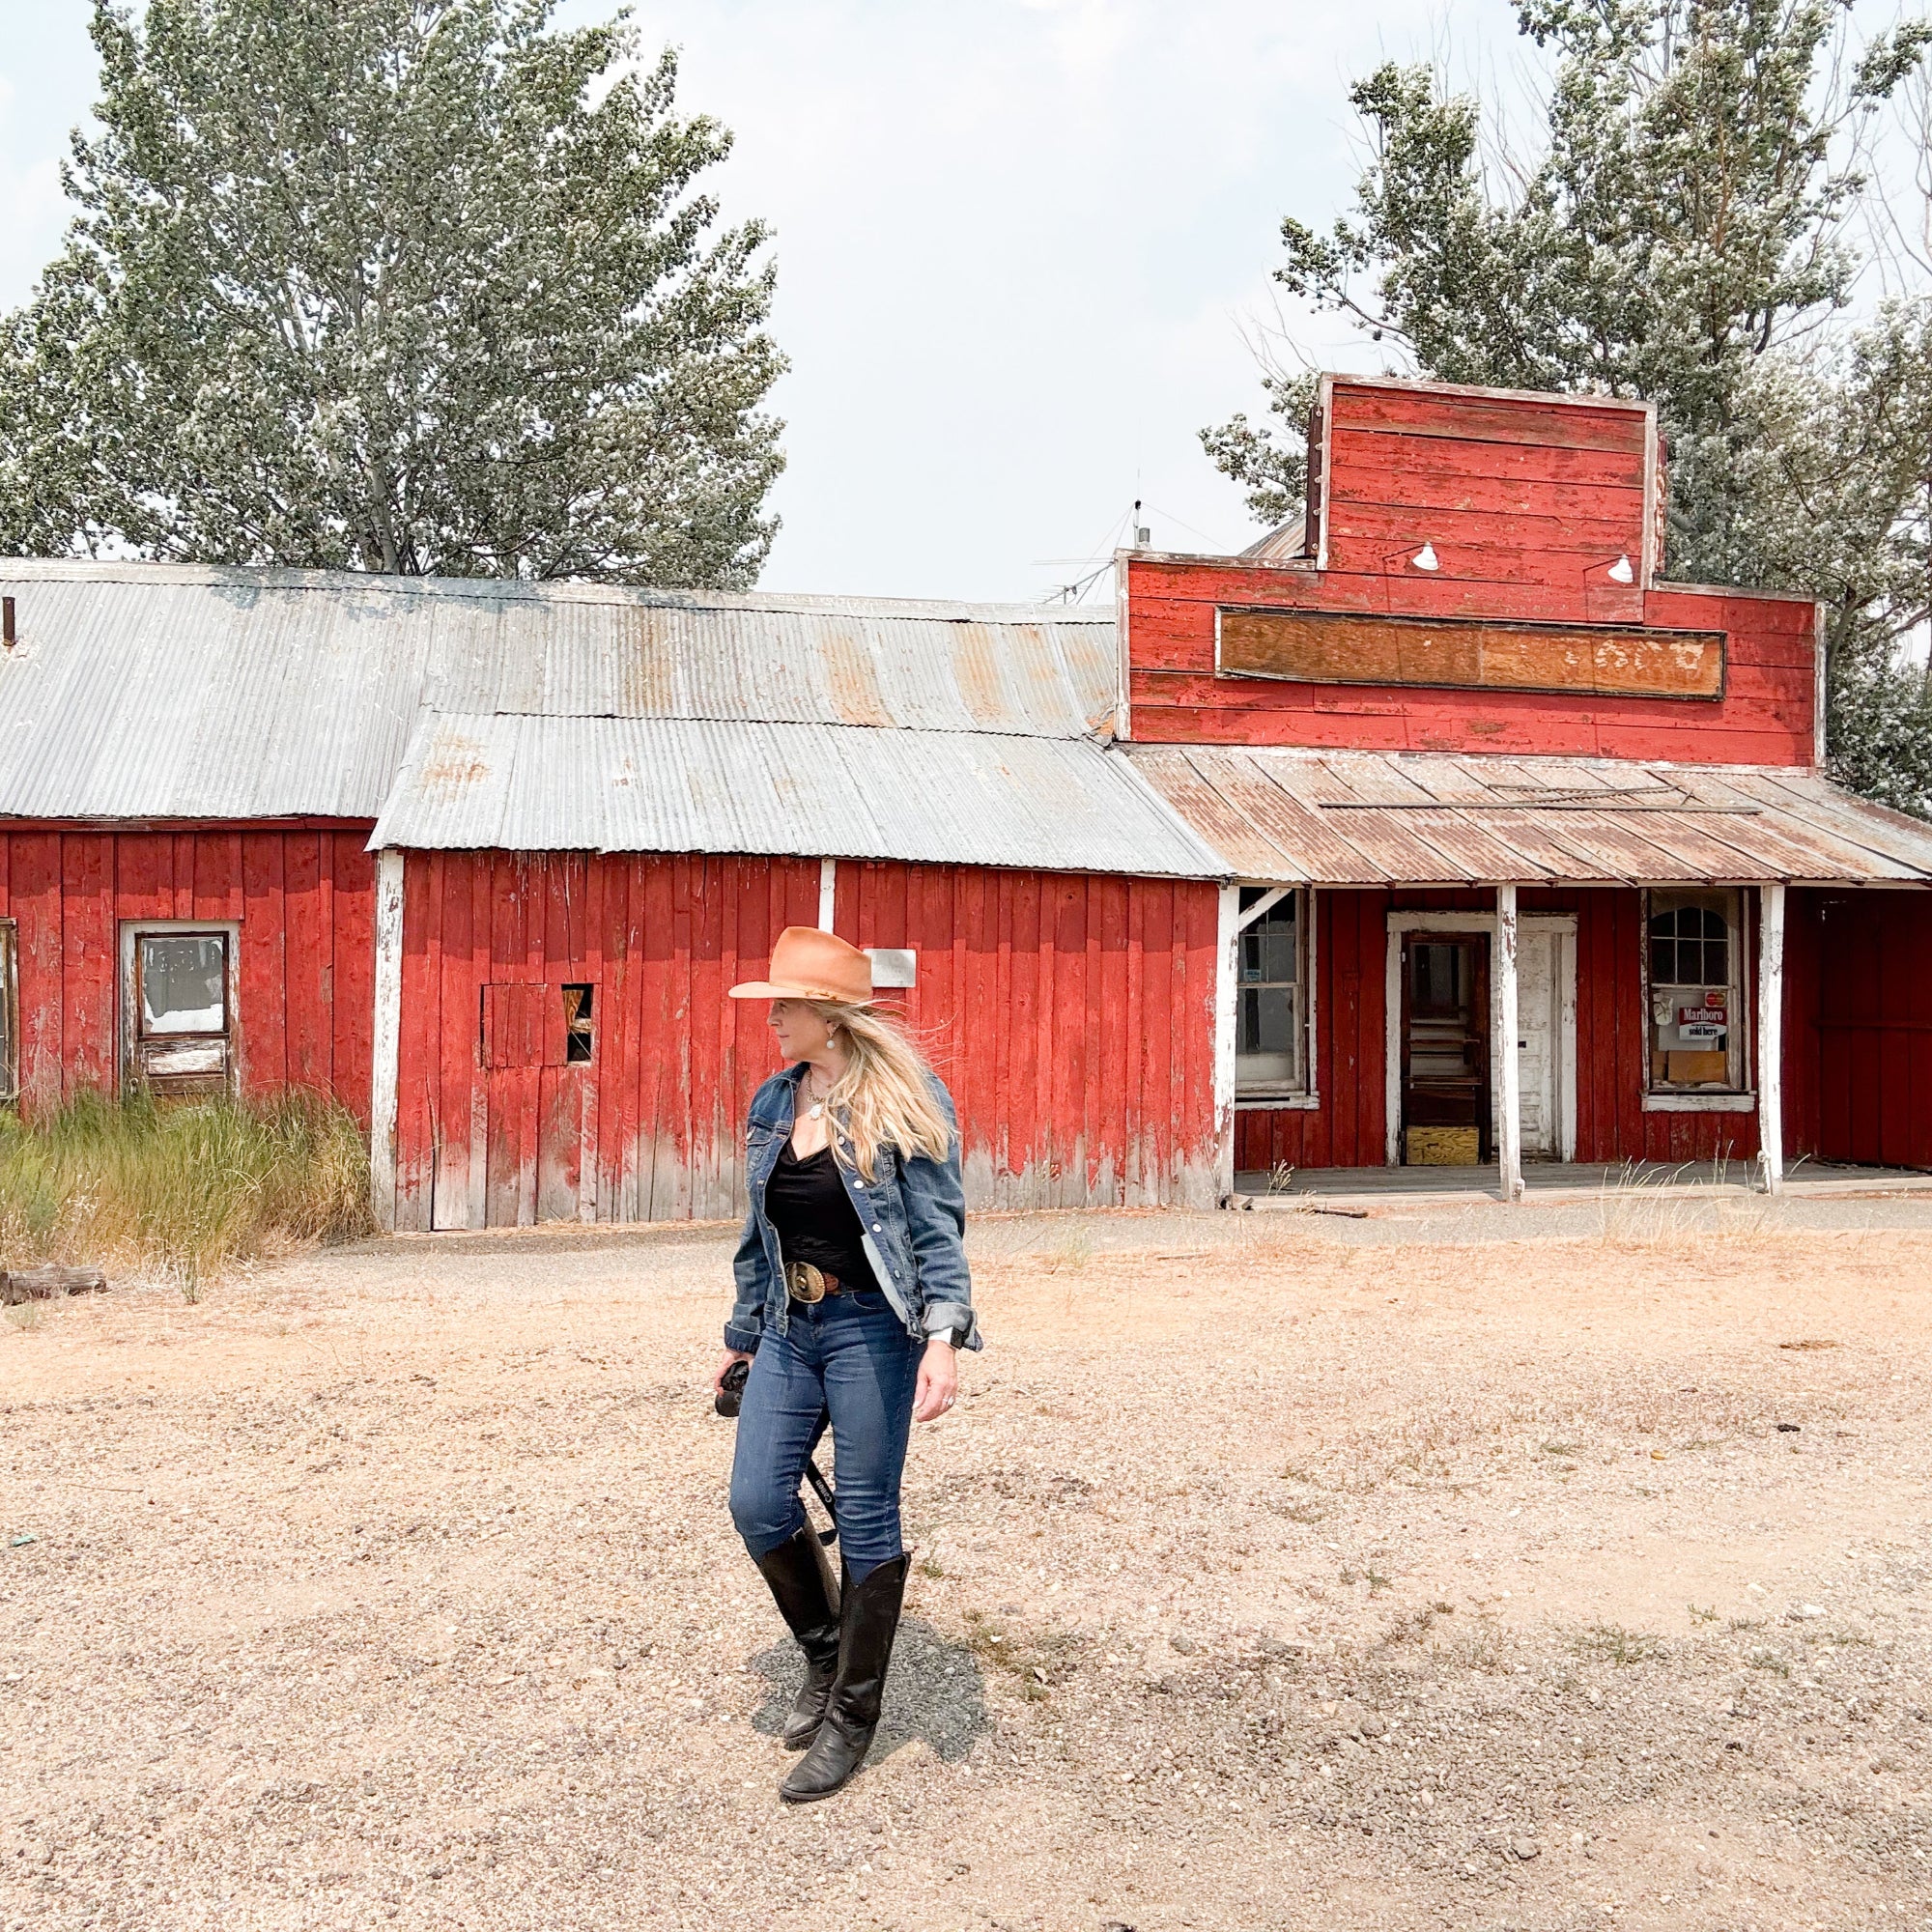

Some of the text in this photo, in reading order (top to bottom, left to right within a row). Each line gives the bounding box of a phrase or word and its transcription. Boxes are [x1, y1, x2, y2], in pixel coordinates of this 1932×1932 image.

[1684, 1008, 1723, 1021] Marlboro
[1689, 1027, 1718, 1036] sold here
[815, 1479, 832, 1503] Canon
